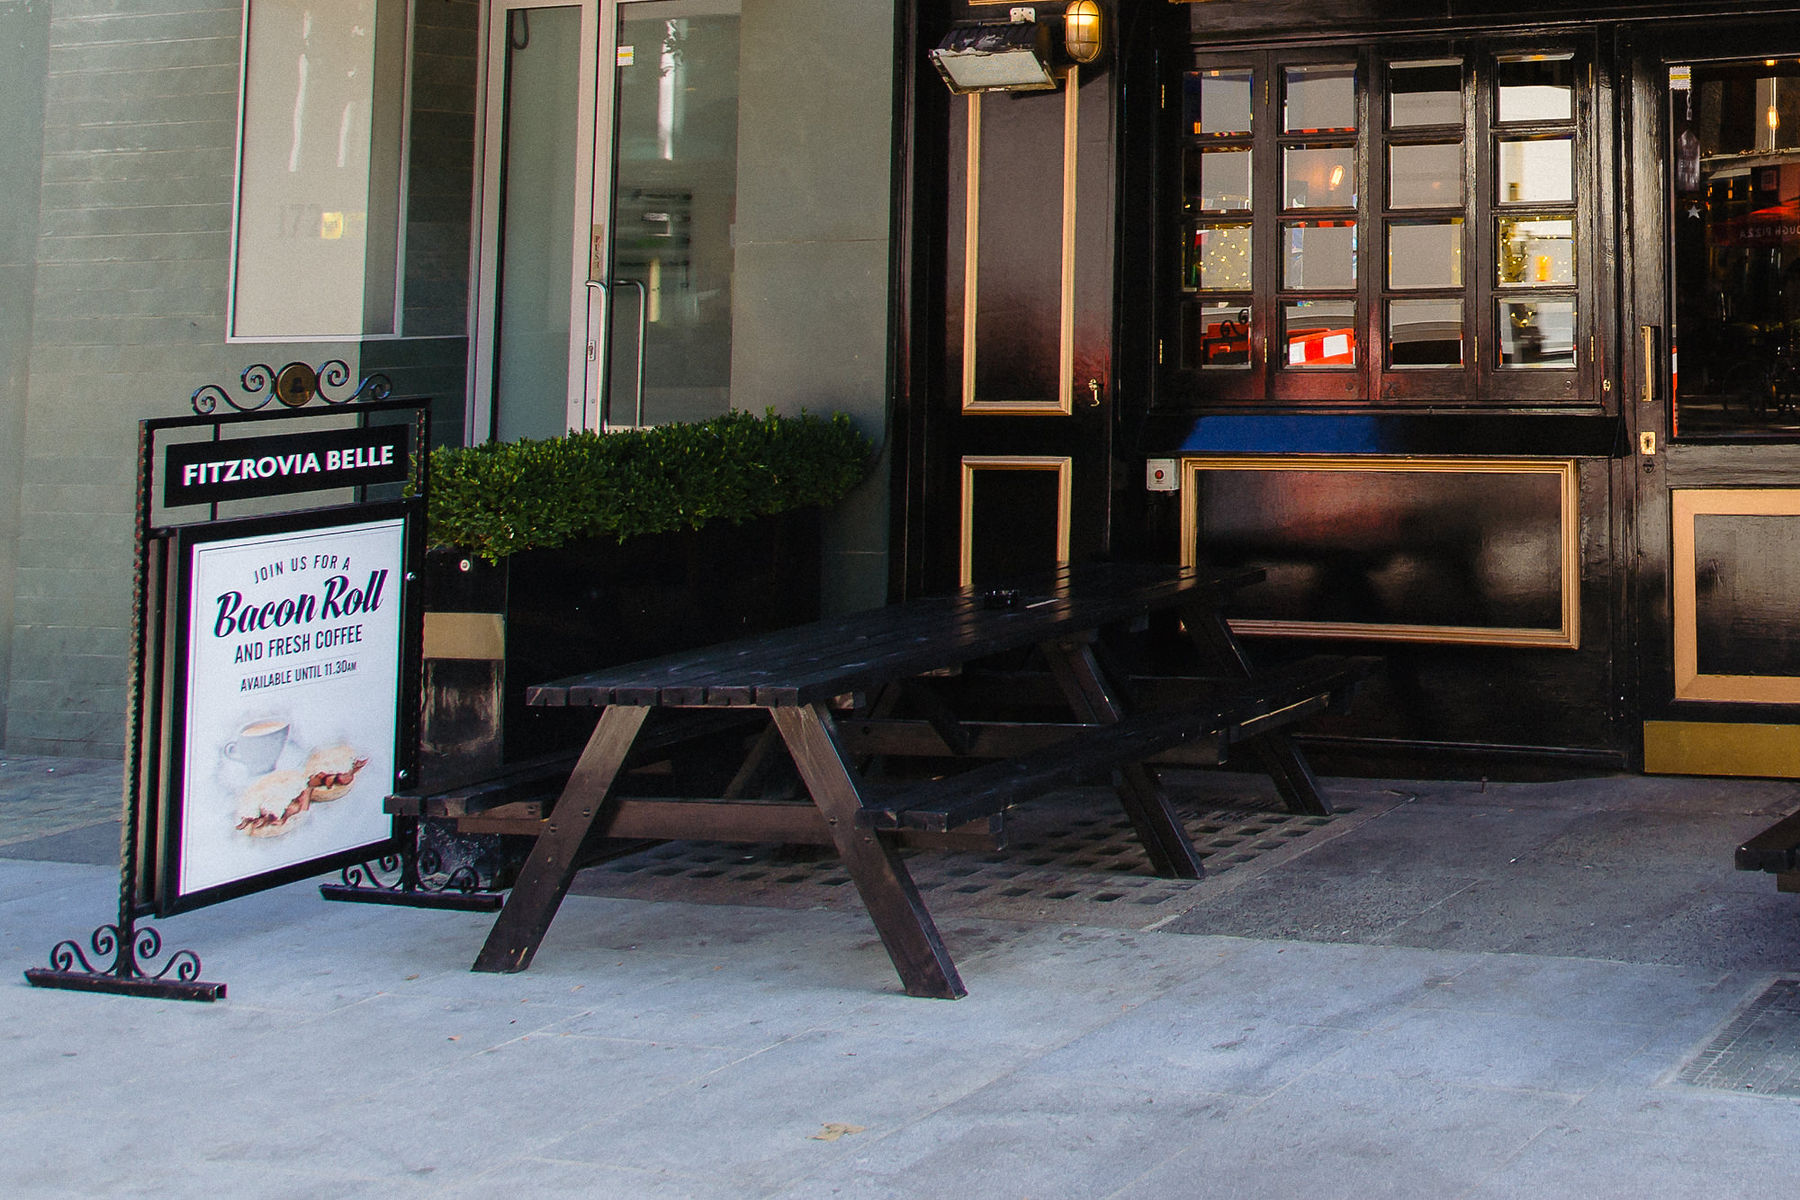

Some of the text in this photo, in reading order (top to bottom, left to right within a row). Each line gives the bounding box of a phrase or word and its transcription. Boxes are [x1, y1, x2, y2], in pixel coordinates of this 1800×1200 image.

[183, 445, 395, 487] FITZROVIA BELLE
[254, 554, 351, 585] JOIN US FOR A
[213, 569, 389, 638] Bacon Roll
[234, 624, 363, 664] AND FRESH COFFEE
[240, 669, 292, 693] AVAILABLE
[295, 664, 322, 682] UNTIL
